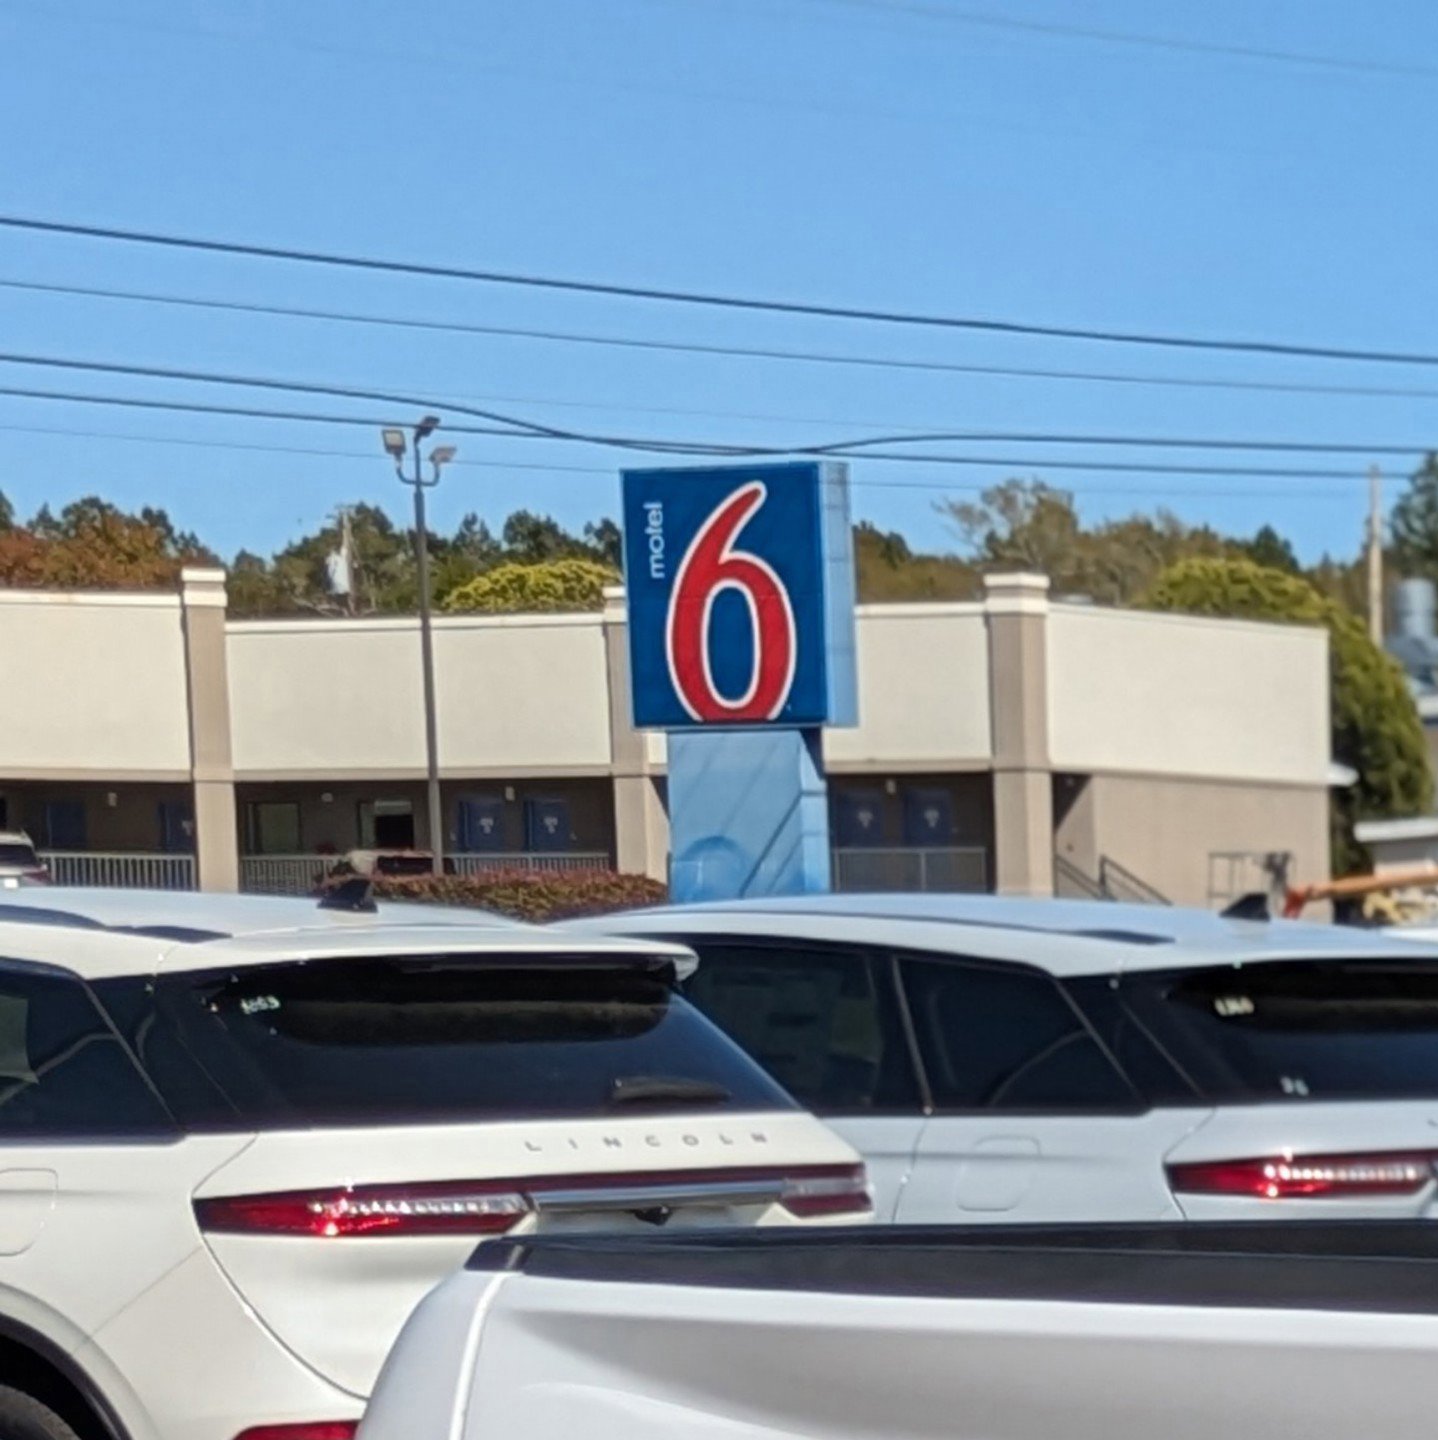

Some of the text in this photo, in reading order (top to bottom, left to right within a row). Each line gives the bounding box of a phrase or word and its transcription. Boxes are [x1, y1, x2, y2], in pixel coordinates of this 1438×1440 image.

[643, 501, 665, 580] motel
[665, 480, 796, 720] 6
[525, 1132, 767, 1151] LINCOLN
